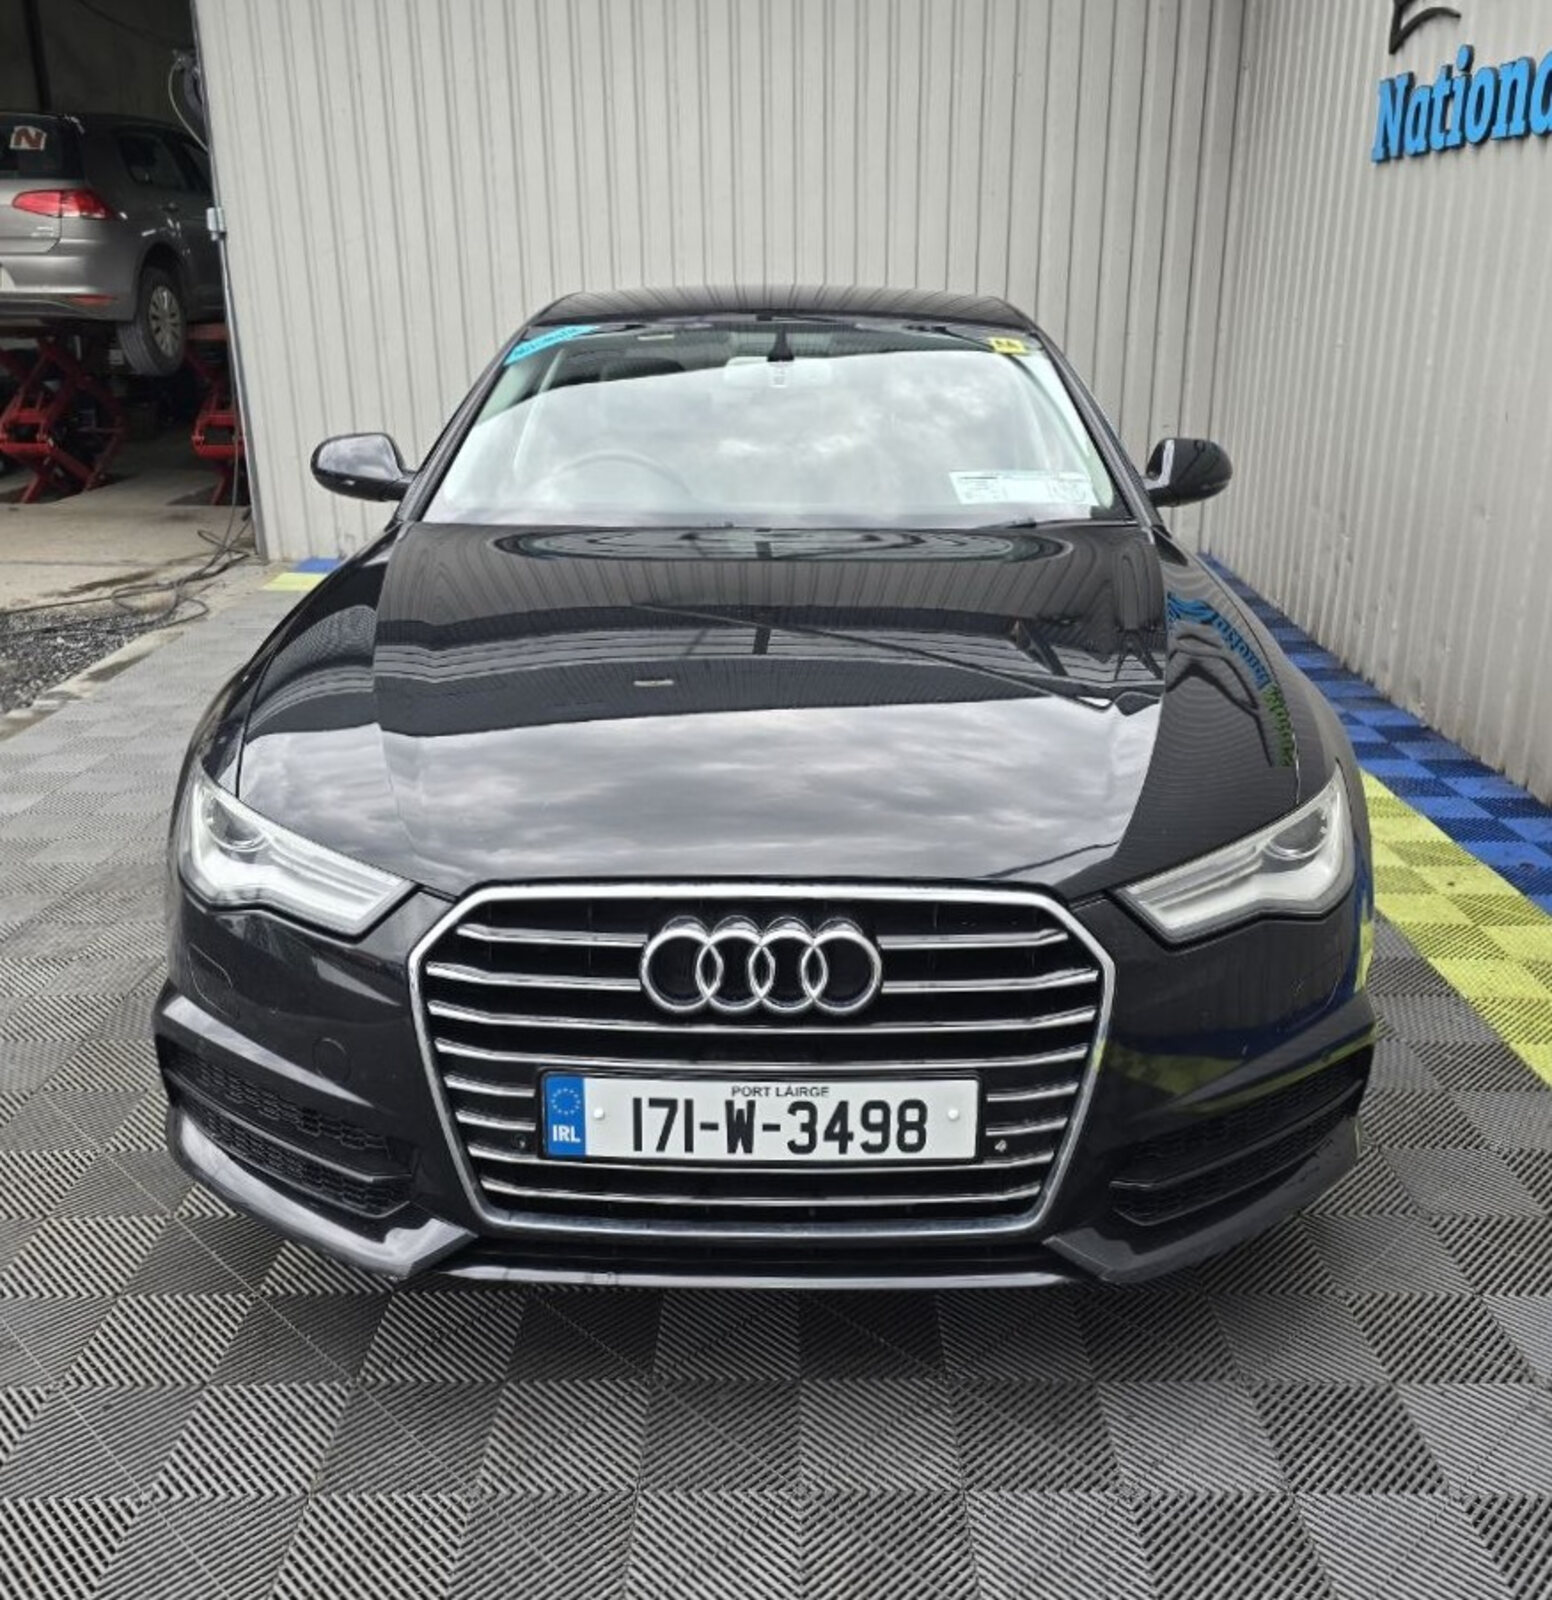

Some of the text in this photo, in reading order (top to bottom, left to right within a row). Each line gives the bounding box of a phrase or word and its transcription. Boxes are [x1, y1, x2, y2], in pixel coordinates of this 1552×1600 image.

[731, 1085, 771, 1097] PORT
[552, 1124, 581, 1143] IRL
[632, 1097, 928, 1155] 171-W-3498
